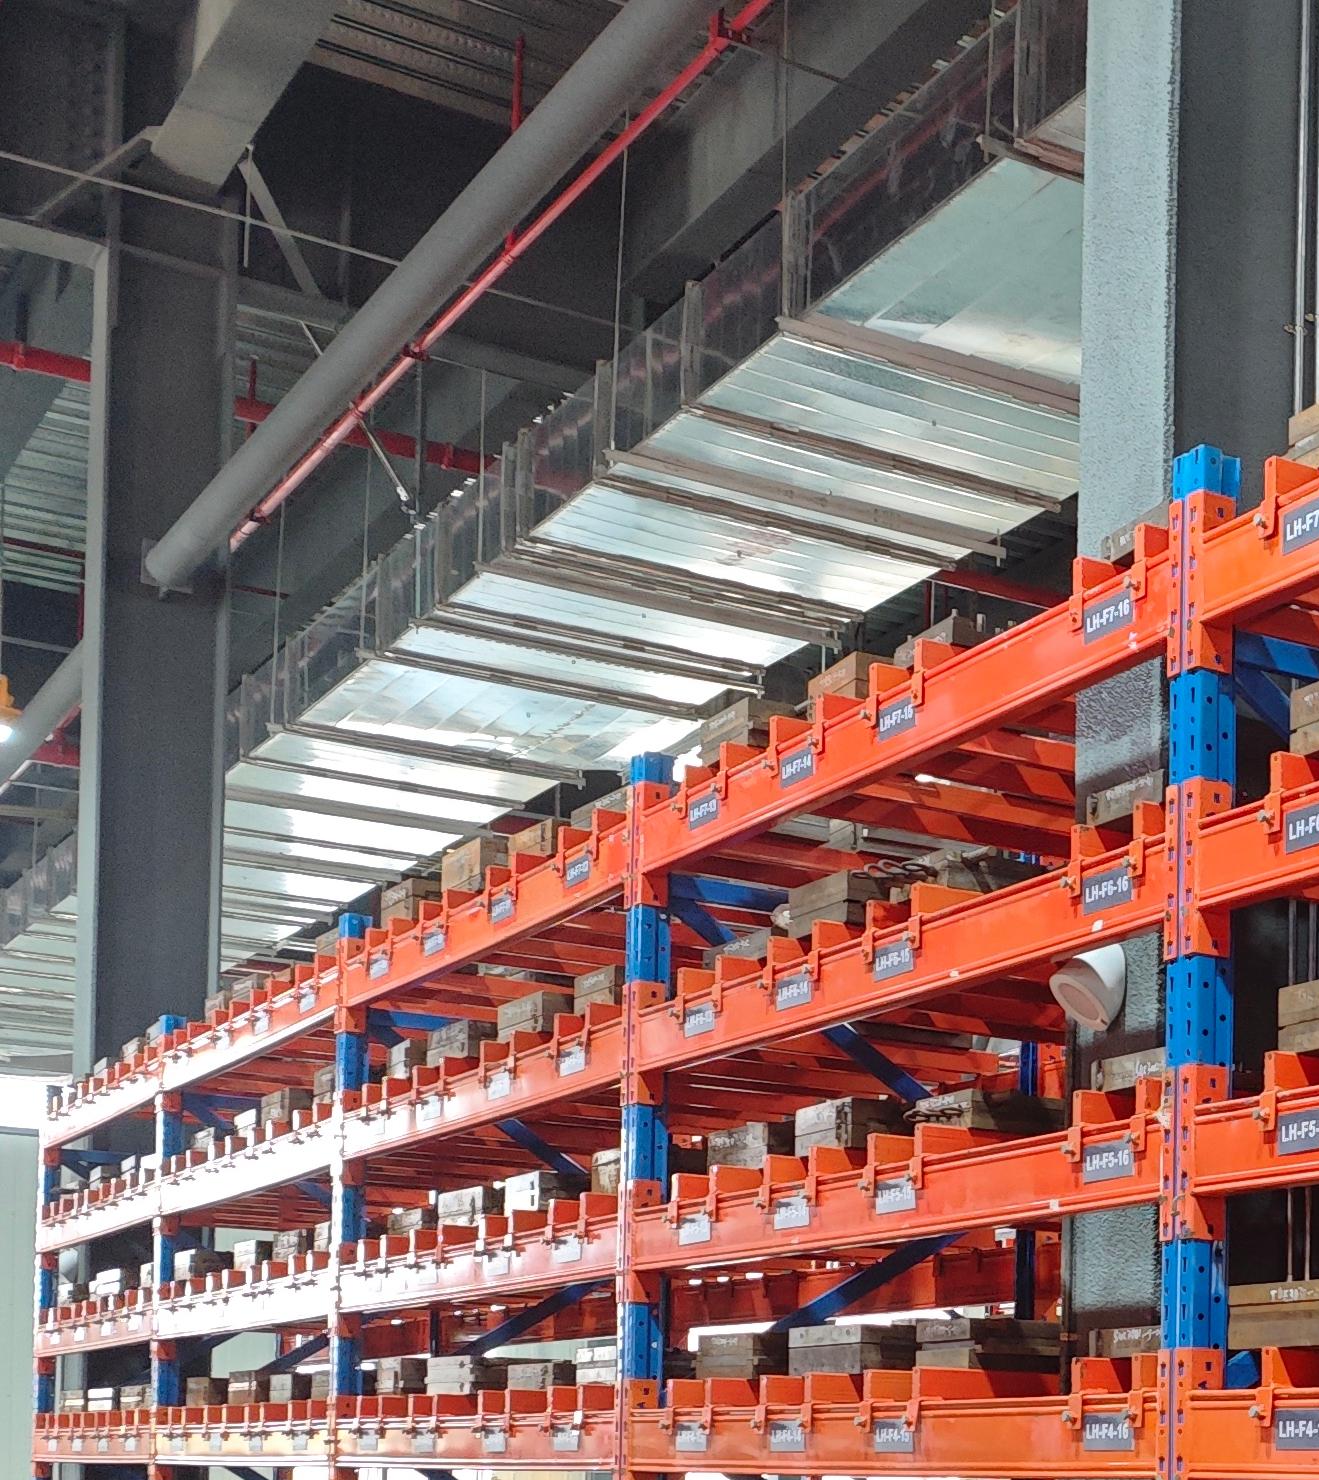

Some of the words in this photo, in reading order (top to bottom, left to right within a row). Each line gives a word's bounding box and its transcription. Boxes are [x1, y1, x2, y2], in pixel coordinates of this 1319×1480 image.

[1086, 599, 1130, 633] LH-F7-16
[880, 704, 913, 732] LH-F7-15
[1085, 876, 1130, 903] LH-F6-16
[1086, 1149, 1129, 1172] LH-F5-16
[1085, 1423, 1129, 1440] LH-F4-16
